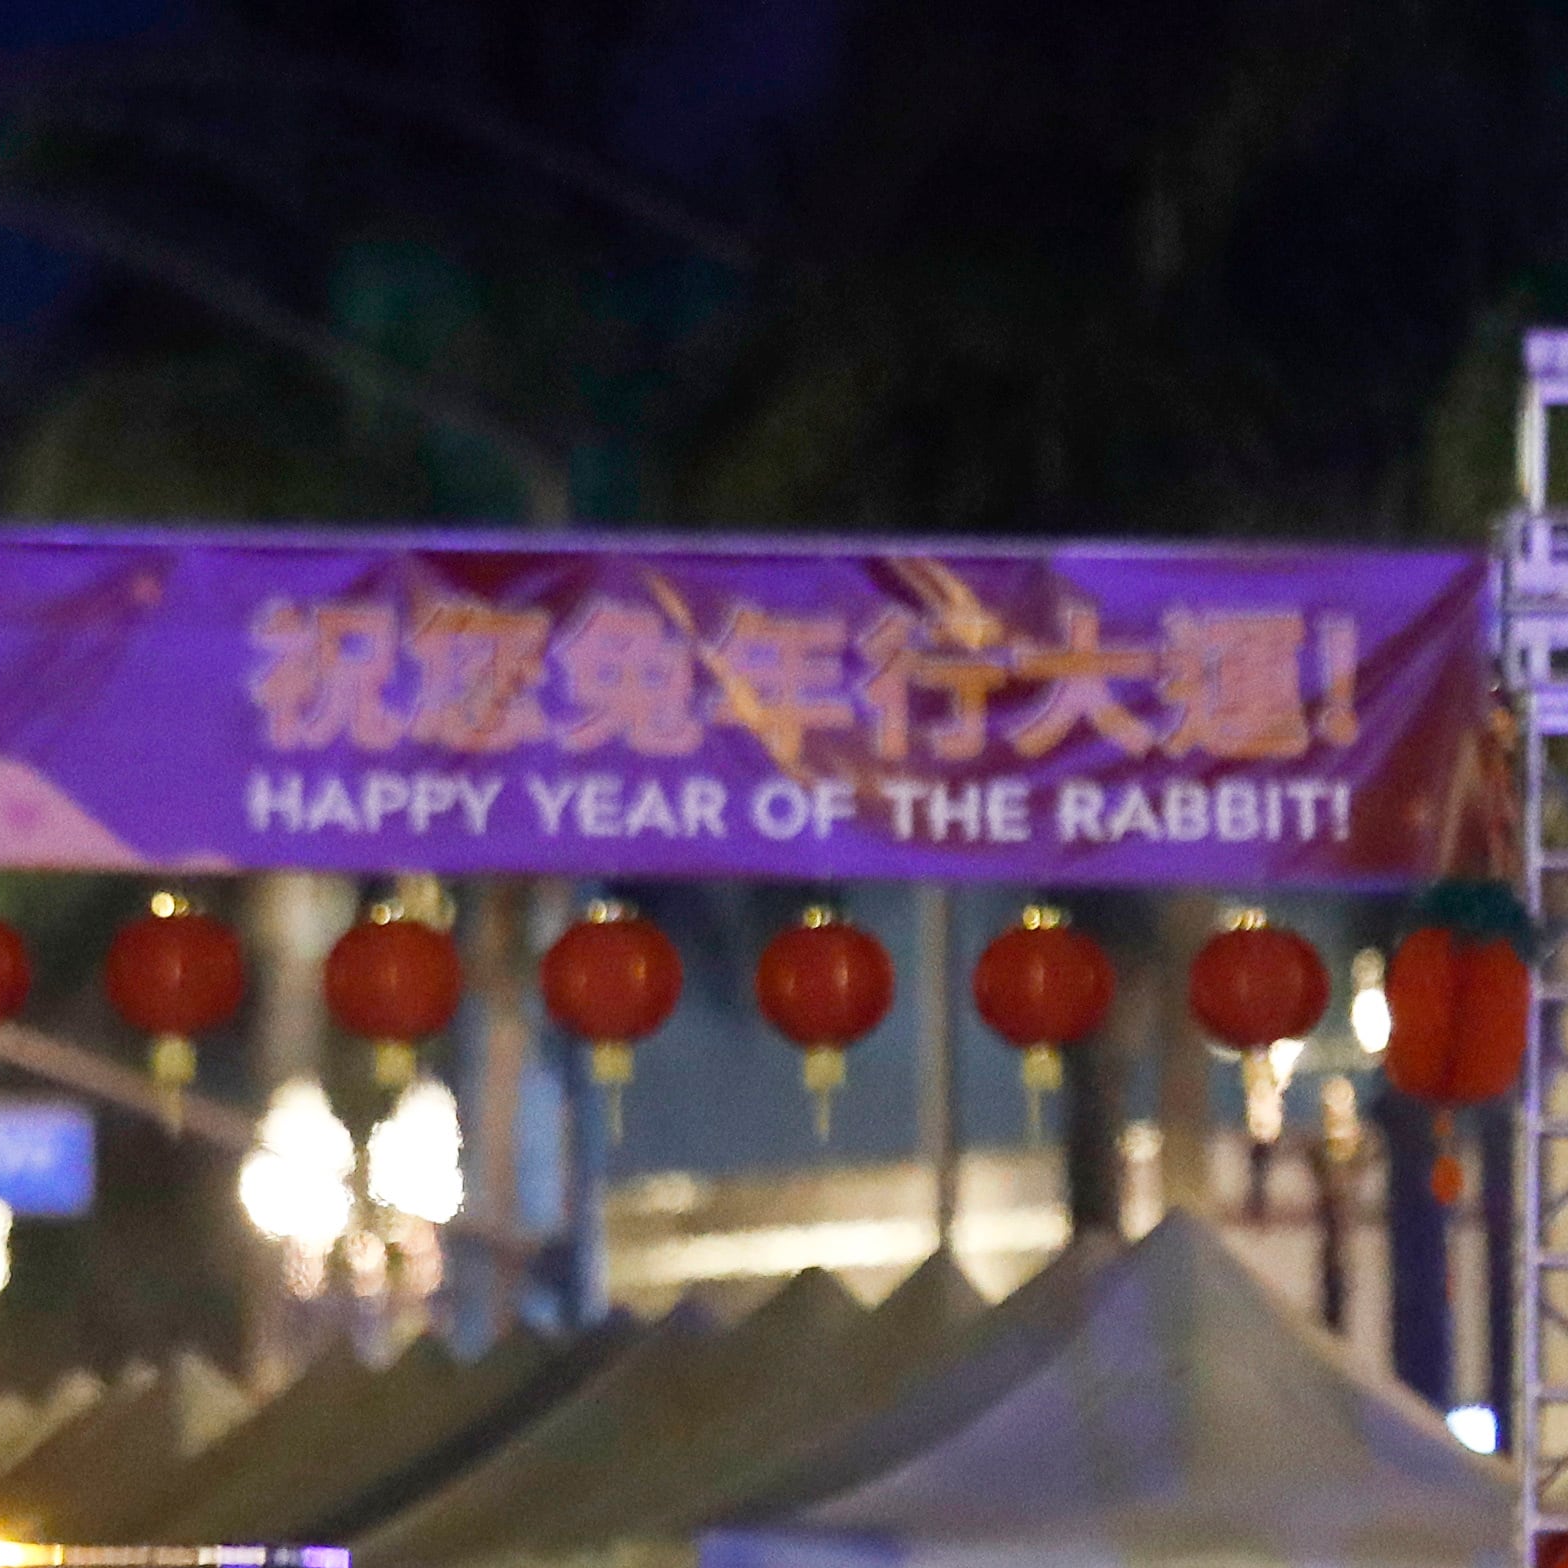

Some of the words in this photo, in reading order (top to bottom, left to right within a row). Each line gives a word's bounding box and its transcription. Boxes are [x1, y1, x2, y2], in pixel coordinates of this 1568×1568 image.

[248, 770, 503, 836] HAPPY
[524, 774, 728, 839] YEAR
[749, 776, 856, 841] OF
[881, 778, 1033, 843] THE
[1056, 779, 1351, 844] RABBIT!
